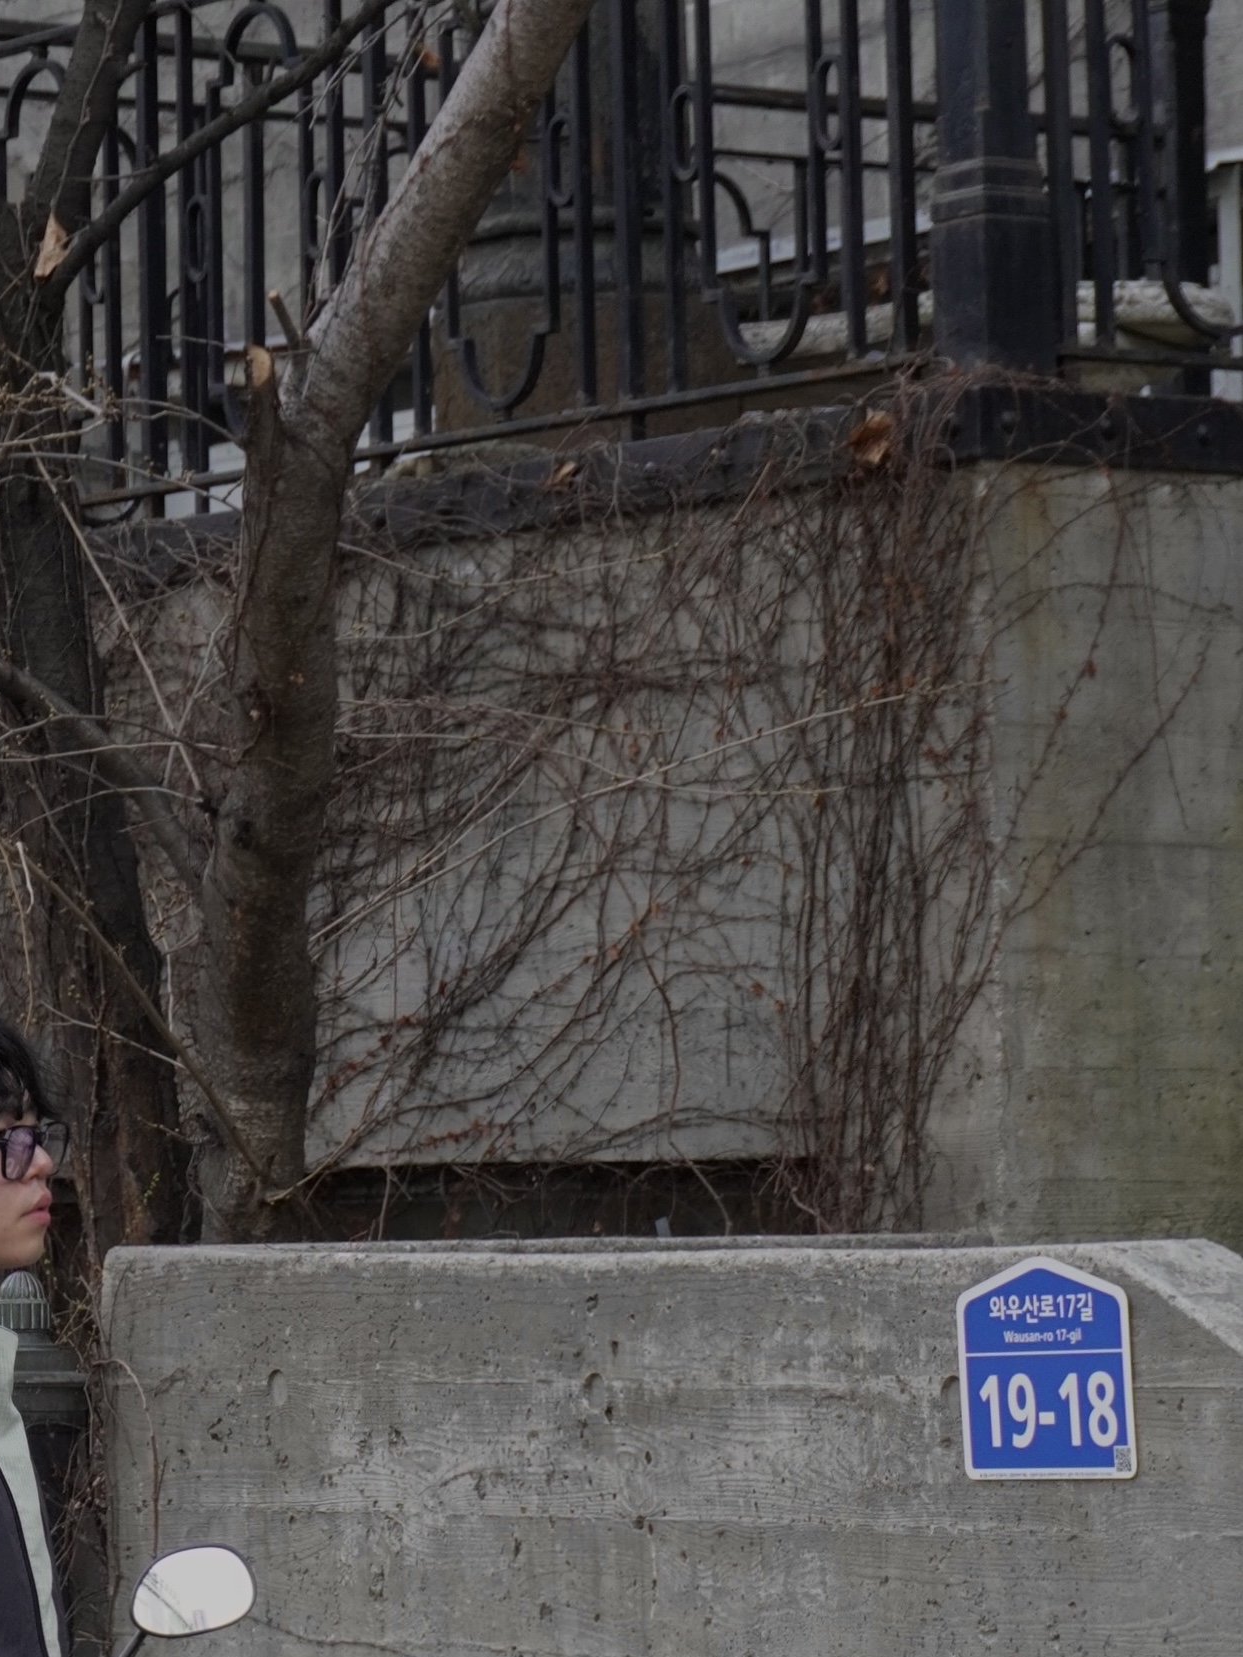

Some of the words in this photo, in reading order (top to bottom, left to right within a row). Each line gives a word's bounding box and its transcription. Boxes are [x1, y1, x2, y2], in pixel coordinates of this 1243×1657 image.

[989, 1292, 1094, 1323] 와우산로17길
[1003, 1329, 1054, 1343] Wausan-ro
[1055, 1328, 1082, 1345] 17-gil
[979, 1370, 1118, 1449] 19-18
